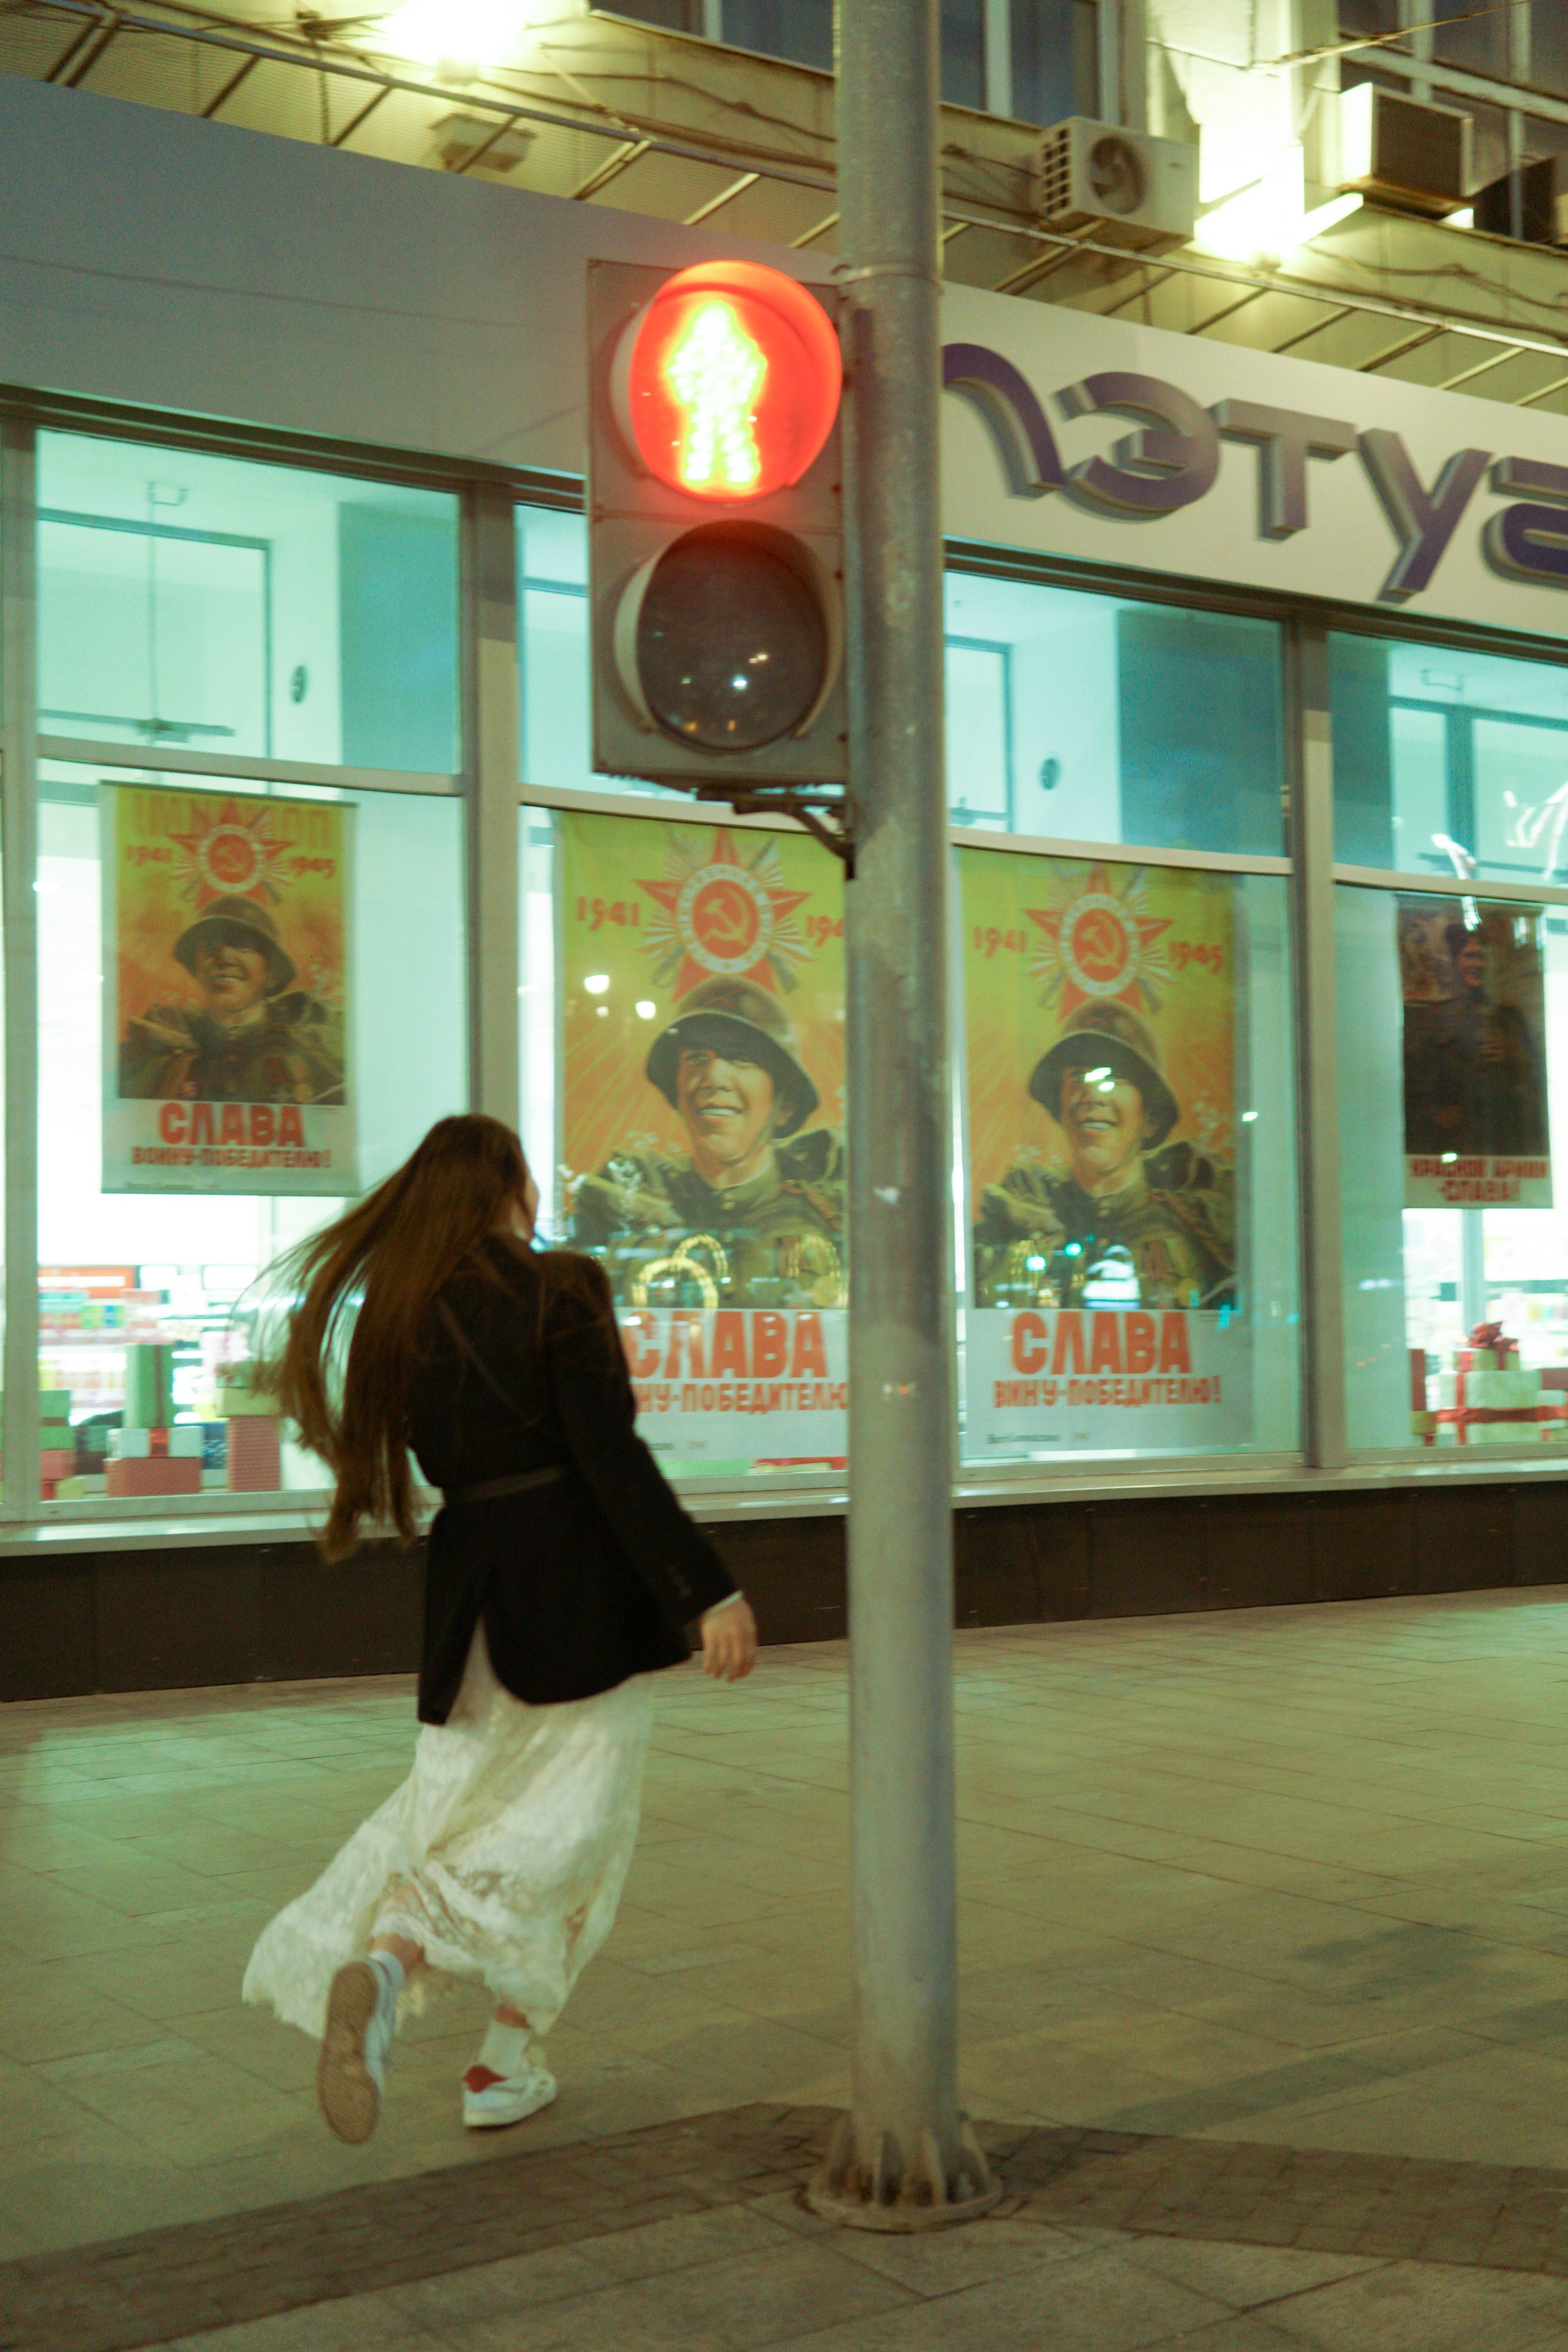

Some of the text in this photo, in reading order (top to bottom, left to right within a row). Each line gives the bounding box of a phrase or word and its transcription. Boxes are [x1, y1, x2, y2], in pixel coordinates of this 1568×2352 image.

[576, 896, 639, 930] 1941
[973, 926, 1028, 958] 1941
[1169, 941, 1222, 974] 1945
[159, 1102, 305, 1147] СЛАВА
[621, 1311, 828, 1379] СЛАВА
[1011, 1311, 1193, 1374] СЛАВА
